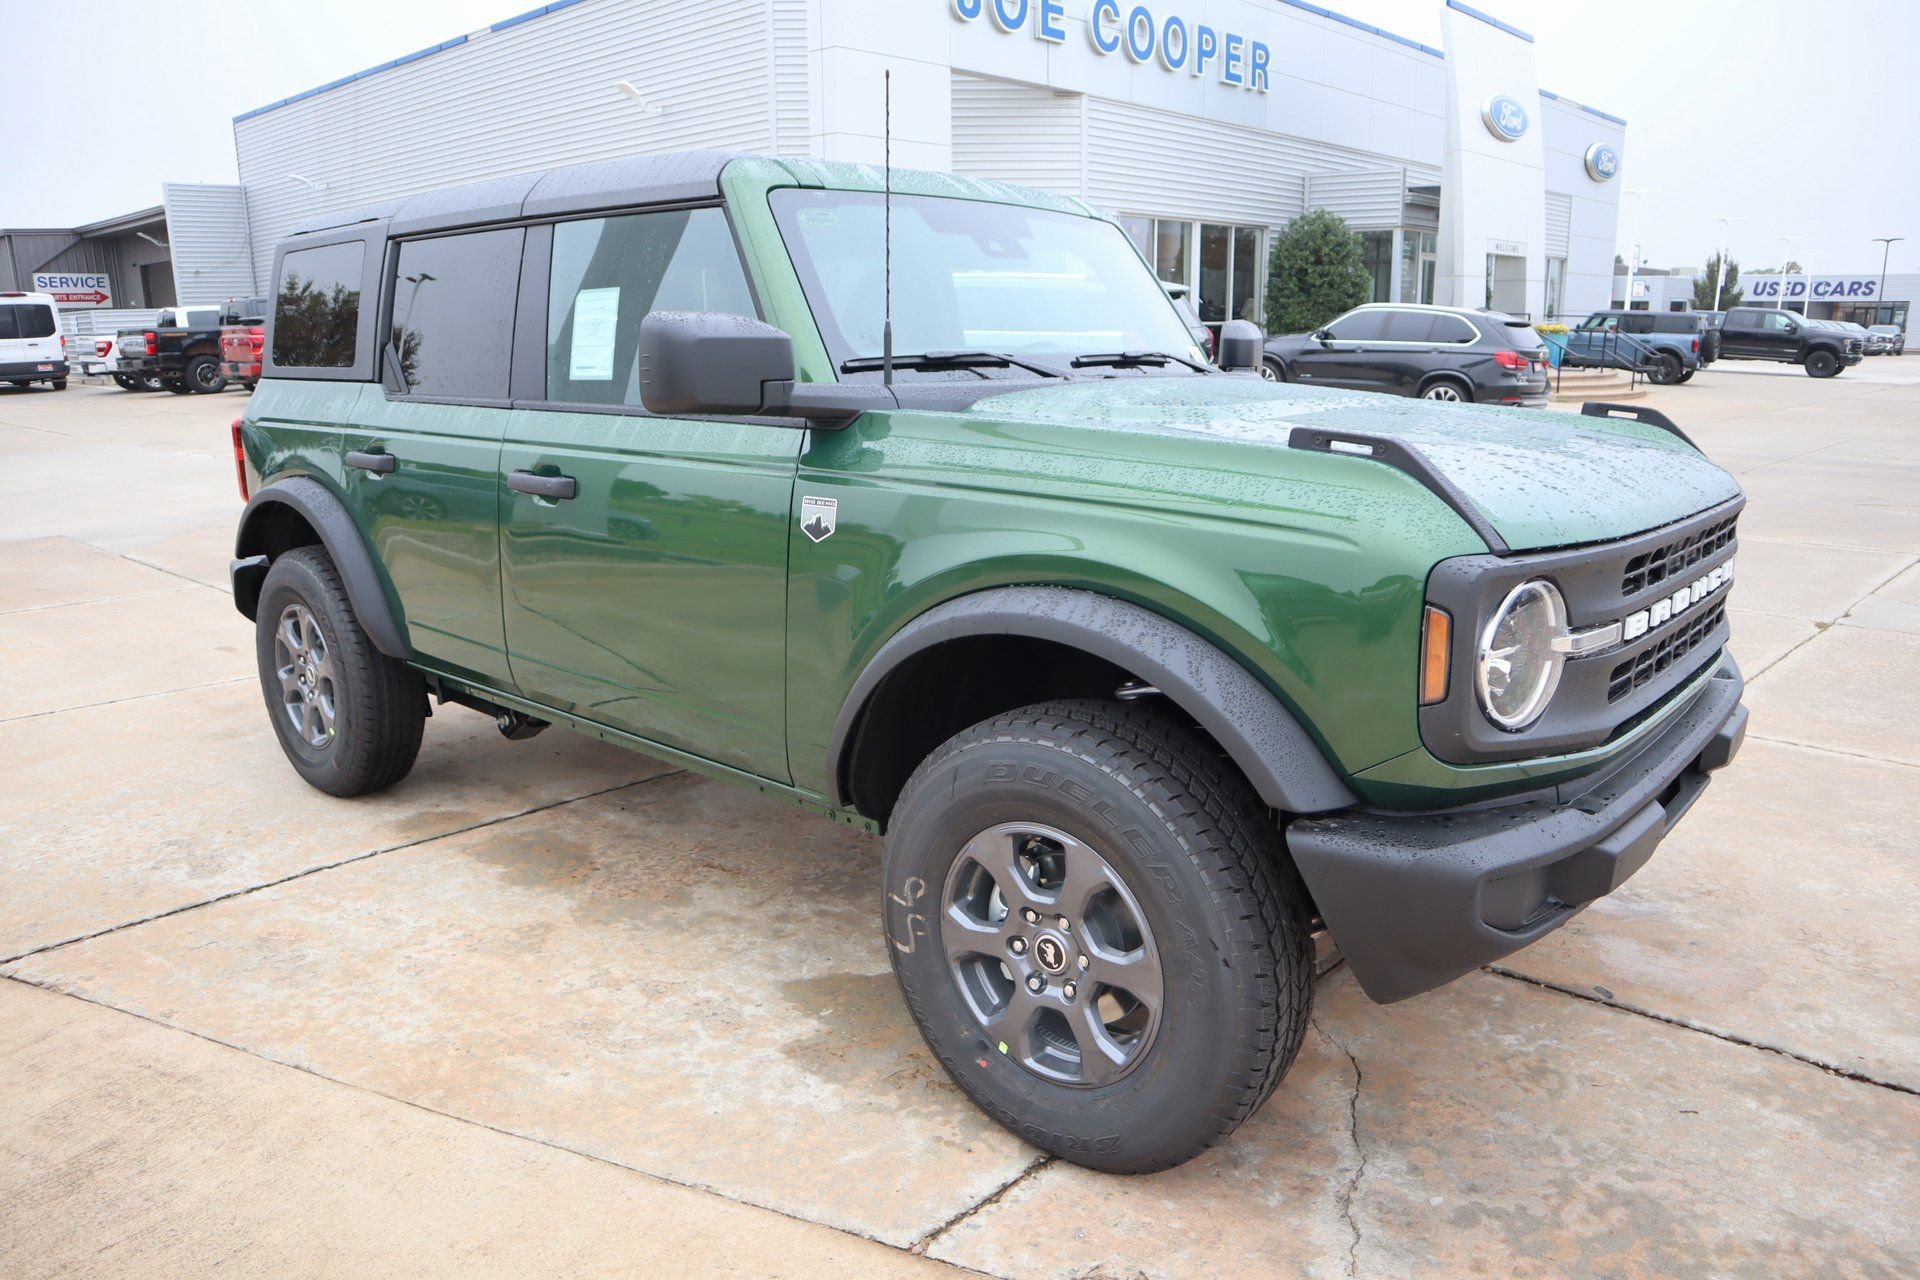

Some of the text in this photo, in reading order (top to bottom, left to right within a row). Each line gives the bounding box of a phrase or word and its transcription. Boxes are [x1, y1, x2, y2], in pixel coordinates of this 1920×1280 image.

[1088, 0, 1271, 93] COOPER
[1500, 101, 1524, 131] Ford
[1598, 150, 1616, 173] Ford
[37, 276, 106, 288] SERVICE
[1812, 280, 1877, 297] CARS
[1623, 556, 1735, 640] BRONCO
[982, 758, 1186, 905] DUELER
[898, 970, 1122, 1155] BRIDGES
